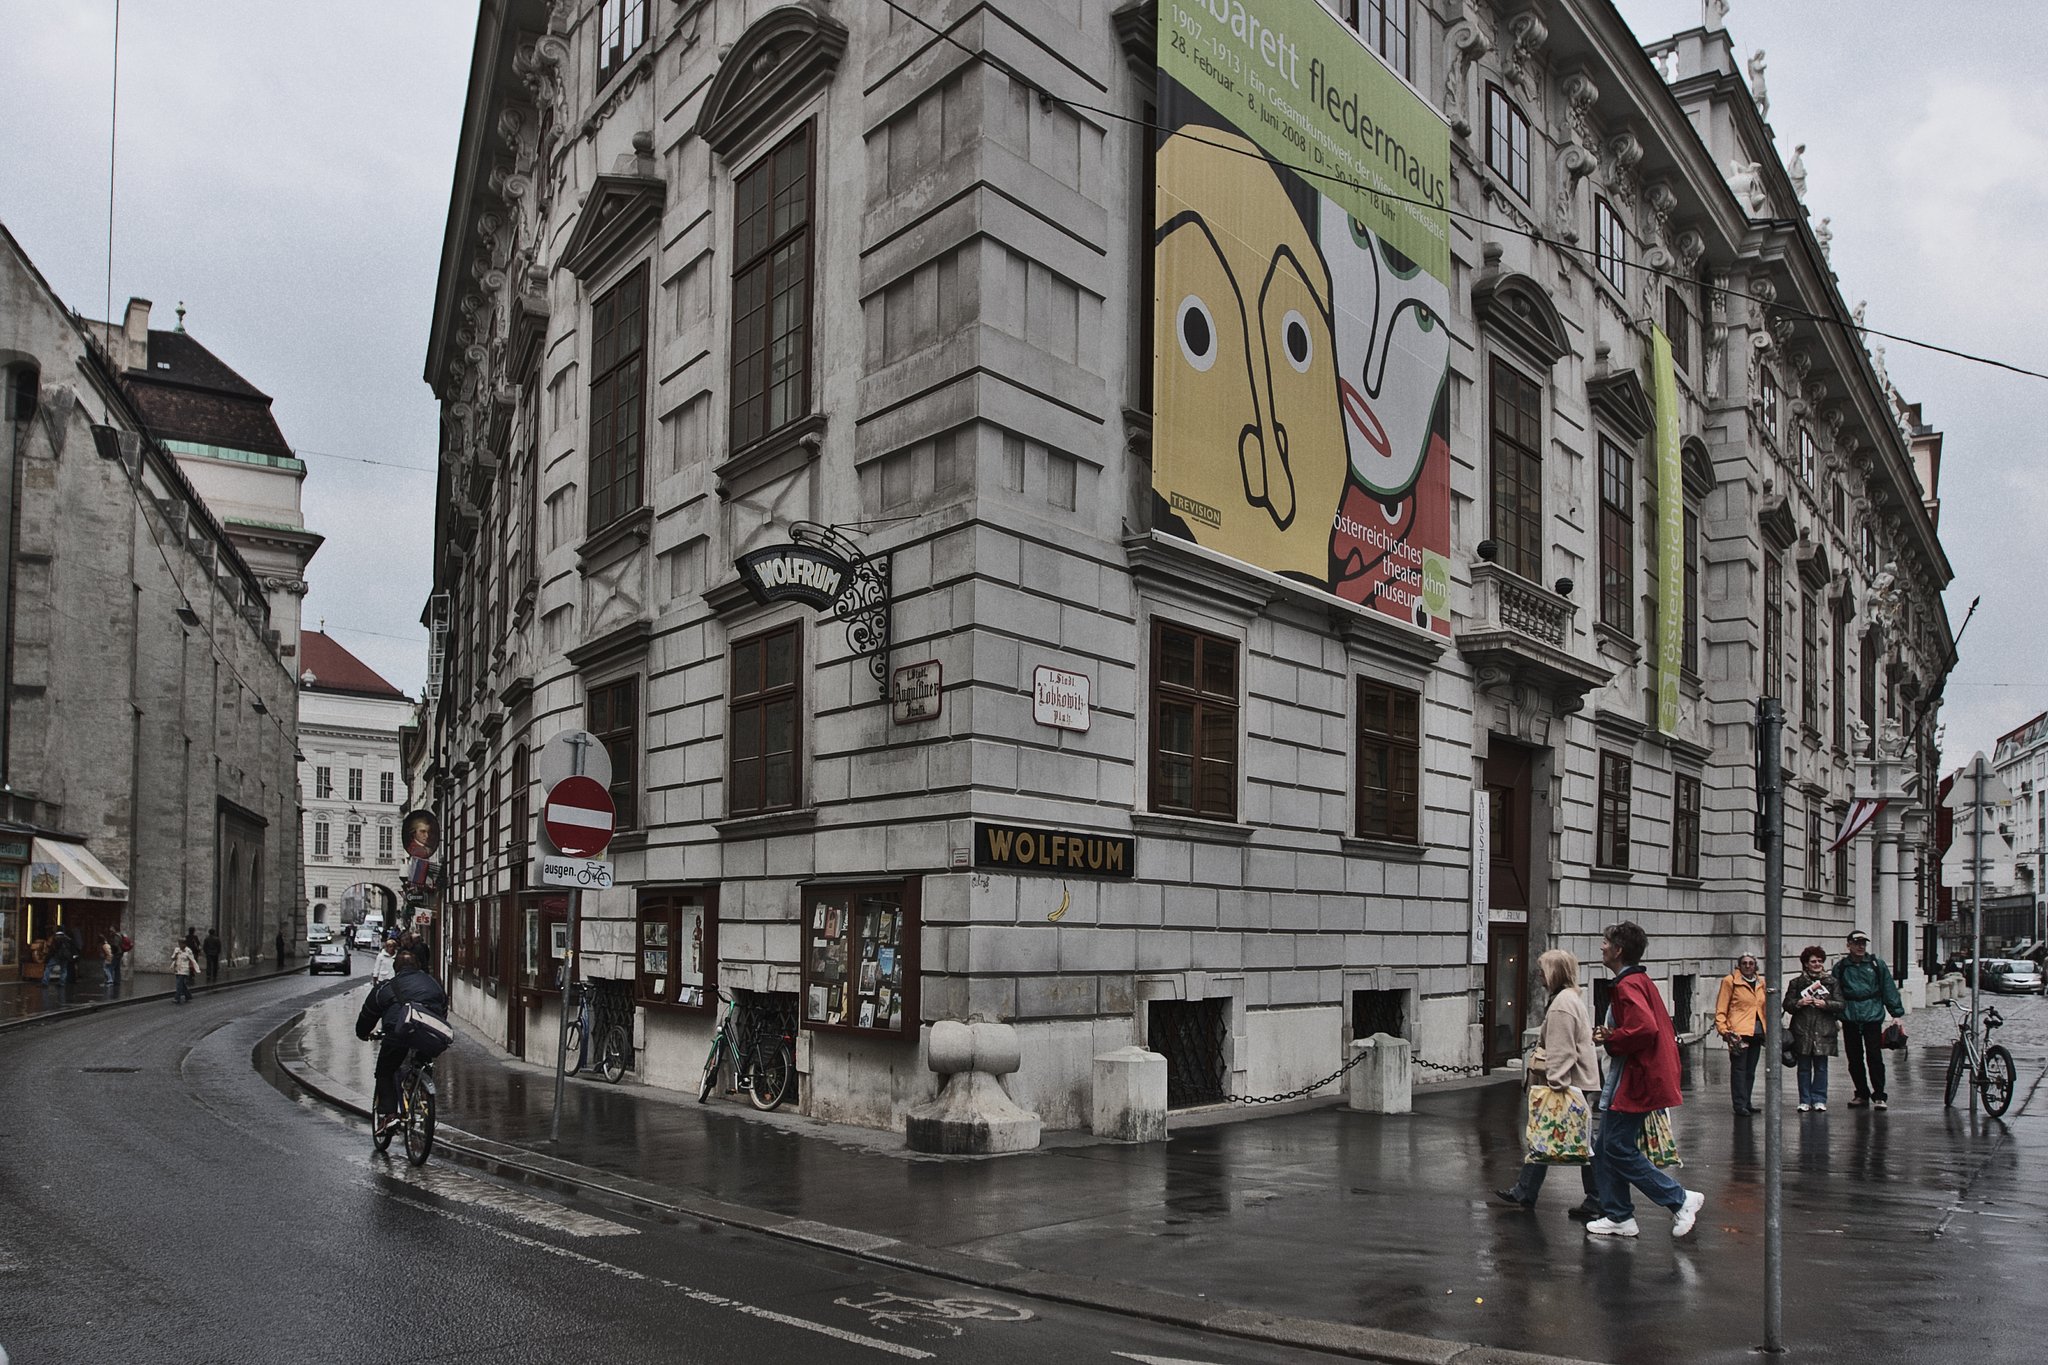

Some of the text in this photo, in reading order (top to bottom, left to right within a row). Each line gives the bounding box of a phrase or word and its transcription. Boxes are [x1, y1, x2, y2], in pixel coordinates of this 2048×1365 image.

[1171, 30, 1190, 58] 28.
[1193, 47, 1235, 92] Februar
[1248, 93, 1258, 114] 8.
[1260, 103, 1279, 131] Juni
[1281, 121, 1306, 152] 2008
[1314, 146, 1325, 167] Di
[1370, 191, 1380, 210] 18
[1250, 69, 1265, 96] Ein
[1268, 87, 1353, 168] Gesamtkunstwerk
[1355, 159, 1370, 181] der
[1309, 57, 1445, 209] fledermaus
[1172, 494, 1220, 524] TREVISION
[1333, 509, 1422, 565] österreichisches
[754, 557, 841, 596] WOLFRUM
[1382, 555, 1422, 588] theater
[1423, 570, 1447, 598] khm
[544, 863, 577, 878] ausgen.
[988, 829, 1123, 871] WOLFRUM
[1476, 796, 1485, 942] AUSSTELLUNG
